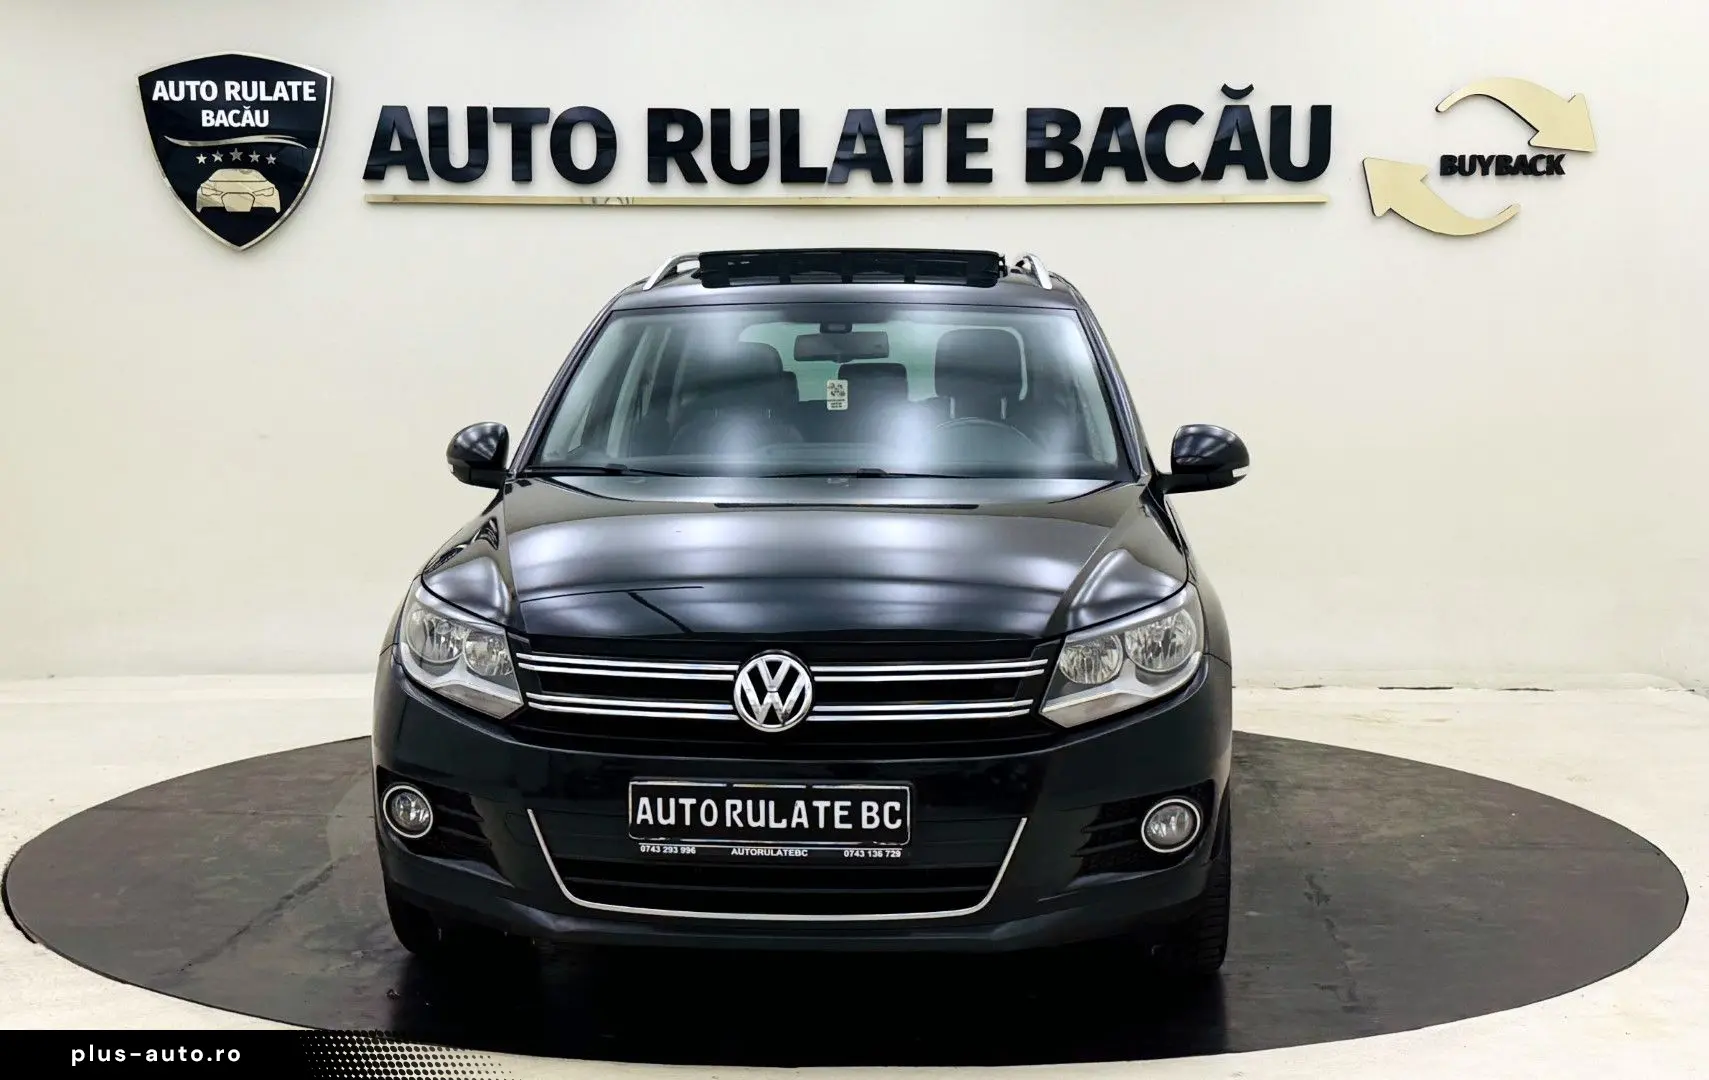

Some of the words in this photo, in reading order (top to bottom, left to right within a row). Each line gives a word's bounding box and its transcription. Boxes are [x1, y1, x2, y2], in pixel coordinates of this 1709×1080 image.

[152, 80, 218, 101] AUTO
[224, 80, 317, 101] RULATE
[201, 105, 269, 128] BACĂU
[362, 105, 618, 184] AUTO
[646, 107, 995, 185] RULATE
[1025, 83, 1333, 184] BACĂU
[1439, 153, 1566, 177] BUYBACK
[636, 797, 719, 827] AUTO
[725, 799, 853, 829] RULATE
[861, 801, 902, 830] BC
[640, 845, 661, 853] 0743
[662, 846, 679, 854] 293
[680, 846, 696, 854] 996
[730, 848, 808, 857] AUTORULATEBC
[843, 849, 865, 858] 0743
[885, 850, 901, 858] 729
